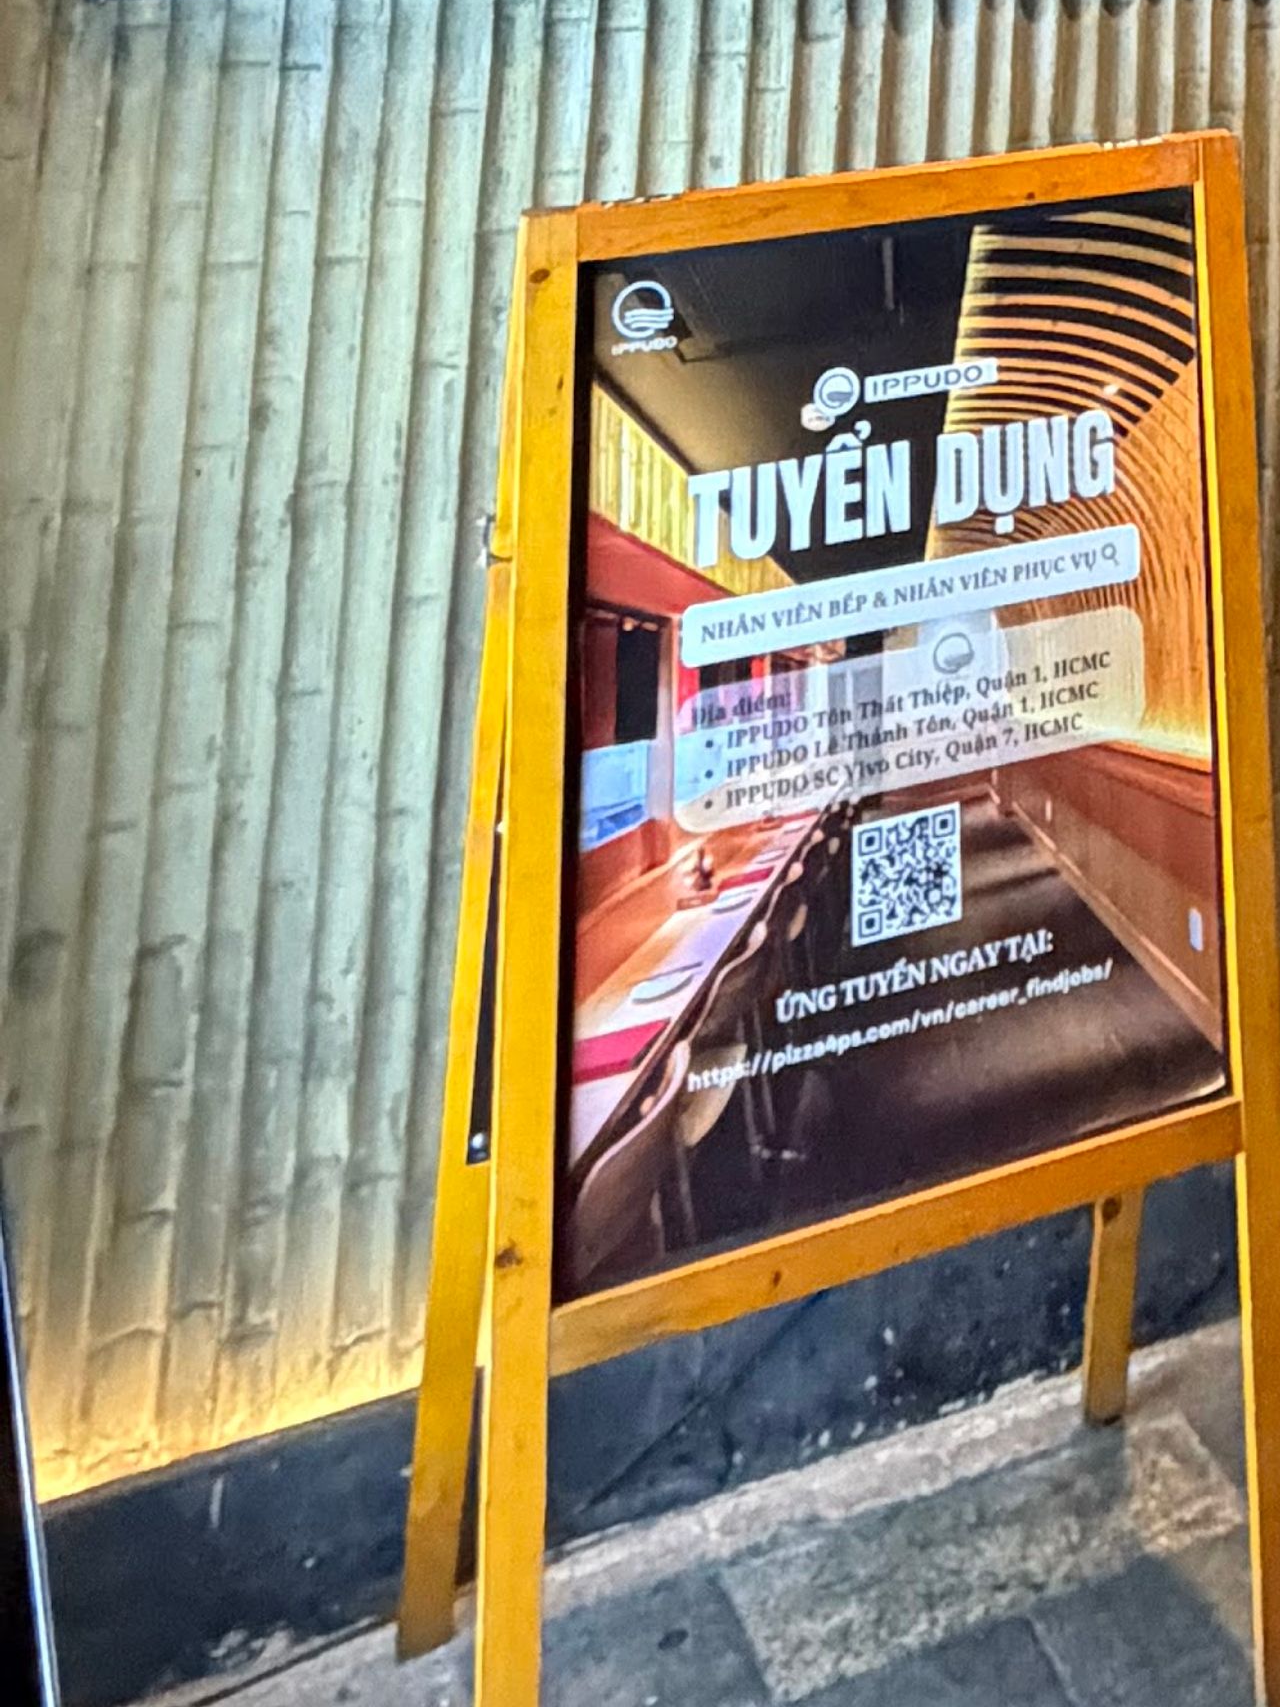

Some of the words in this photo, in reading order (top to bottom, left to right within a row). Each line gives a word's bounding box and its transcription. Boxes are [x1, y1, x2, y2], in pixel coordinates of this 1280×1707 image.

[612, 335, 678, 356] IPPUDO
[873, 365, 982, 396] IPPUDO
[687, 421, 911, 567] TUYỂN
[935, 410, 1116, 534] DỤNG
[701, 612, 766, 643] NHÂN
[772, 601, 823, 628] VIÊN
[829, 591, 867, 619] BẾP
[873, 591, 888, 608] &
[893, 576, 954, 606] NHÂN
[959, 567, 1008, 591] VIÊN
[1013, 556, 1066, 582] PHỤC
[1070, 549, 1097, 572] VỤ
[727, 715, 808, 749] IPPUDO
[813, 709, 852, 728] Tôn
[1053, 651, 1111, 680] HCMC
[727, 744, 808, 778] IPPUDO
[847, 721, 908, 751] Thánh
[1040, 681, 1098, 710] HCMC
[726, 774, 809, 809] IPPUDO
[814, 766, 839, 787] SC
[1024, 713, 1083, 742] HCMC
[687, 956, 1114, 1092] https://pizza4ps.com/vn/career_findjobs/
[775, 989, 837, 1024] ỨNG
[929, 940, 1001, 984] NGAY
[1003, 927, 1054, 964] TẠI:
